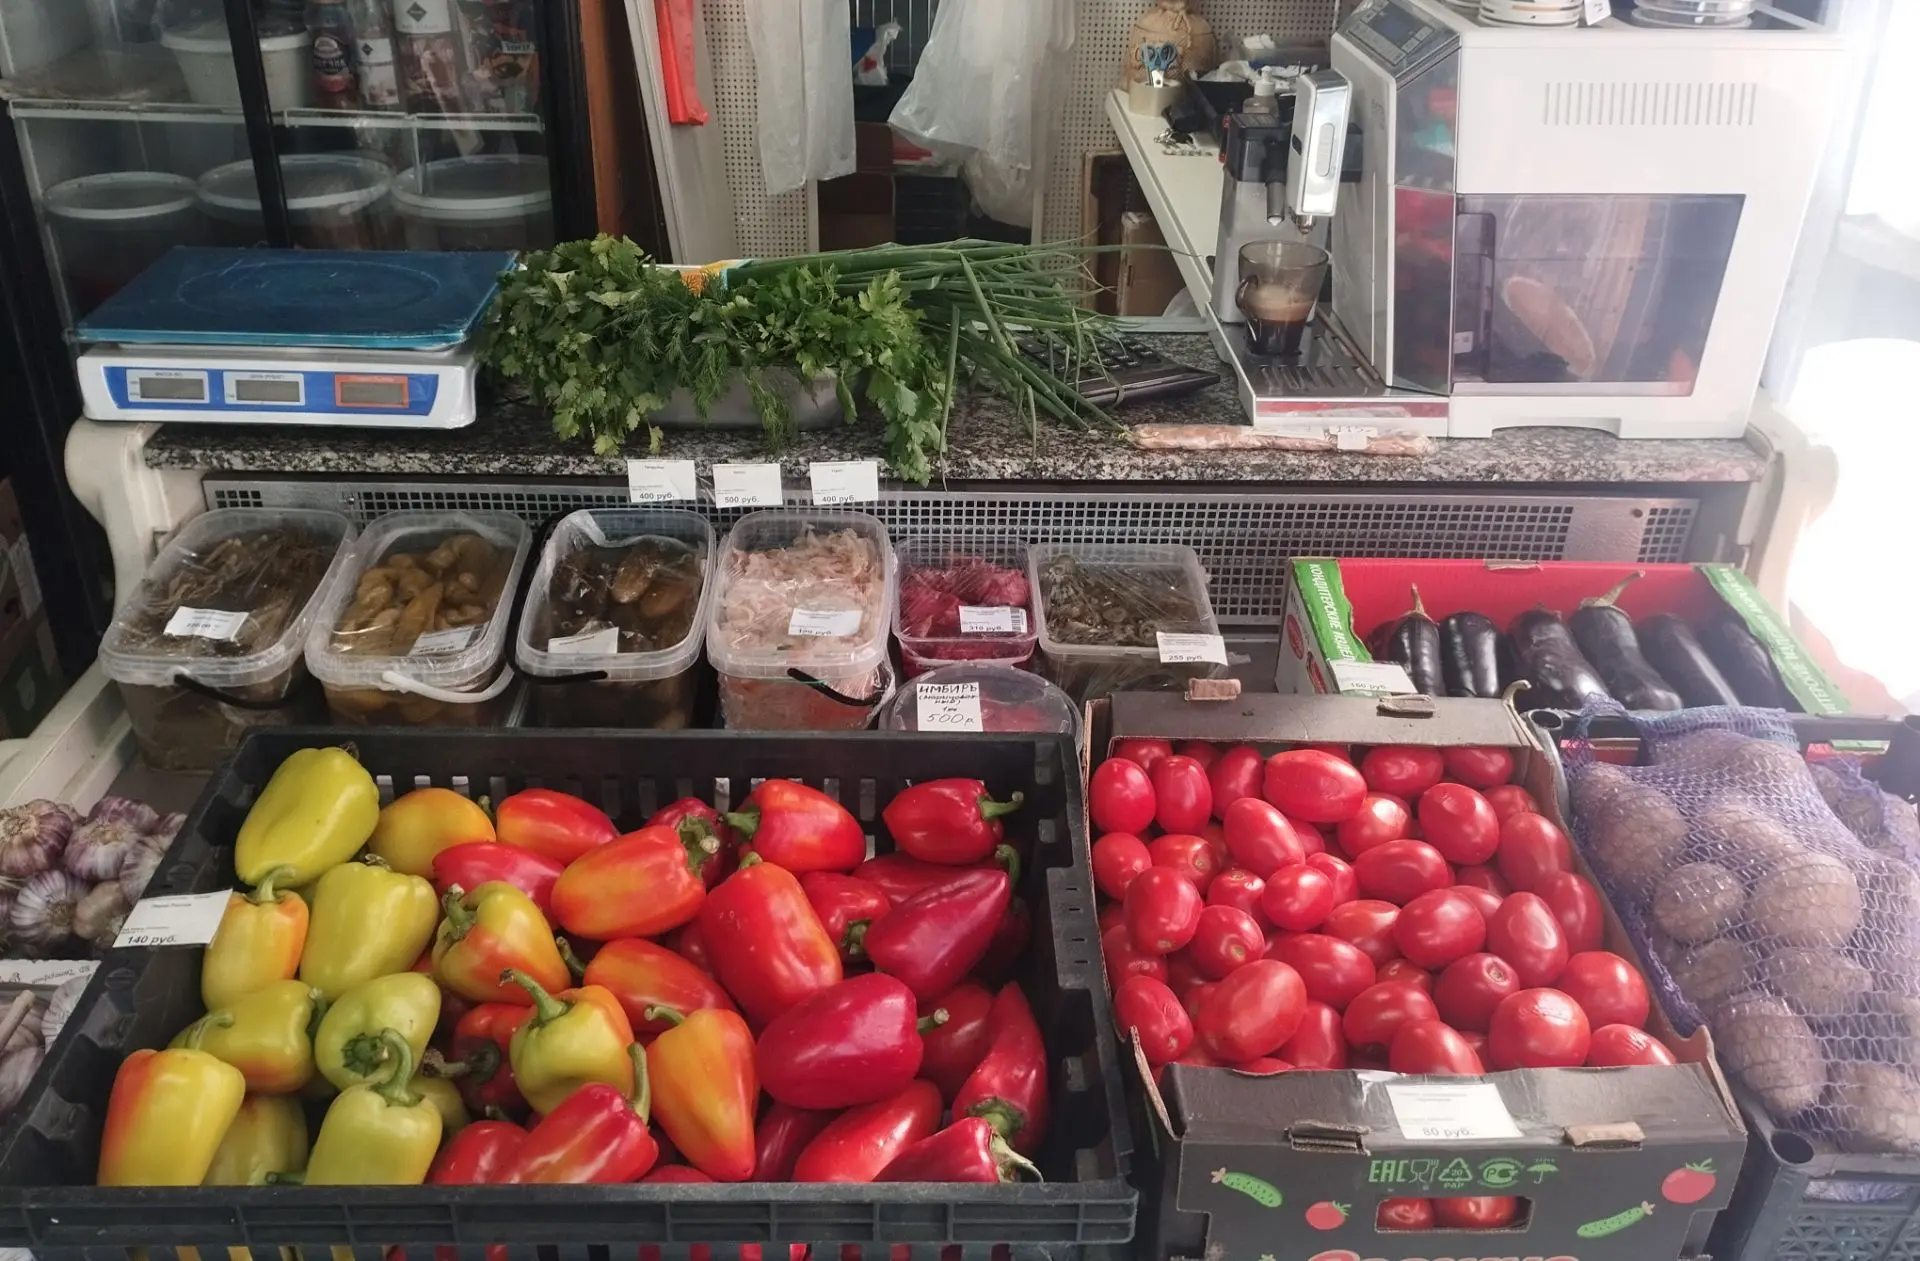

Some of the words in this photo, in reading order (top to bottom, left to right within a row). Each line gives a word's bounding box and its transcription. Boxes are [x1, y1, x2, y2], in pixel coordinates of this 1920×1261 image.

[639, 492, 654, 500] 400
[724, 496, 739, 504] 500
[822, 495, 837, 503] 400
[919, 684, 978, 693] ИМБИРЬ
[128, 935, 149, 944] 140
[150, 935, 177, 946] руб.
[1422, 1127, 1440, 1137] 80
[1443, 1127, 1475, 1138] руб.
